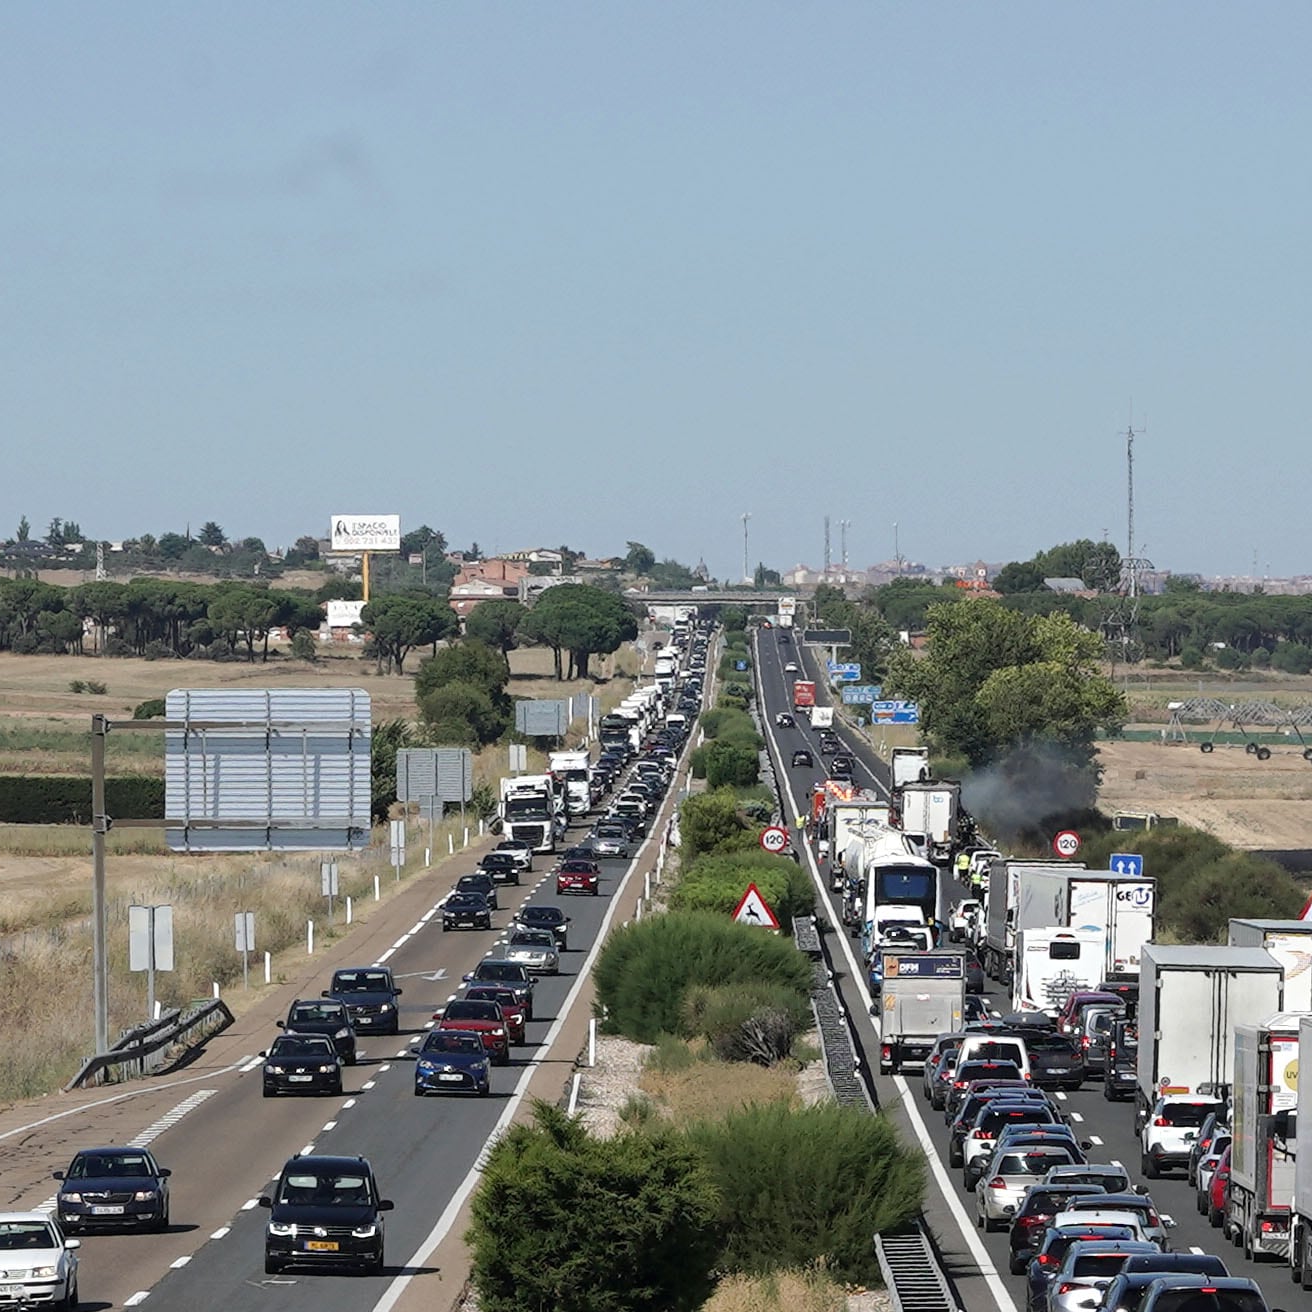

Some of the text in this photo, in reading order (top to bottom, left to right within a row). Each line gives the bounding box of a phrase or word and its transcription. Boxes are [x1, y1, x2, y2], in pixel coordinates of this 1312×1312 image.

[352, 522, 387, 530] ESPACIO
[766, 834, 784, 845] 120
[1059, 839, 1077, 849] 120
